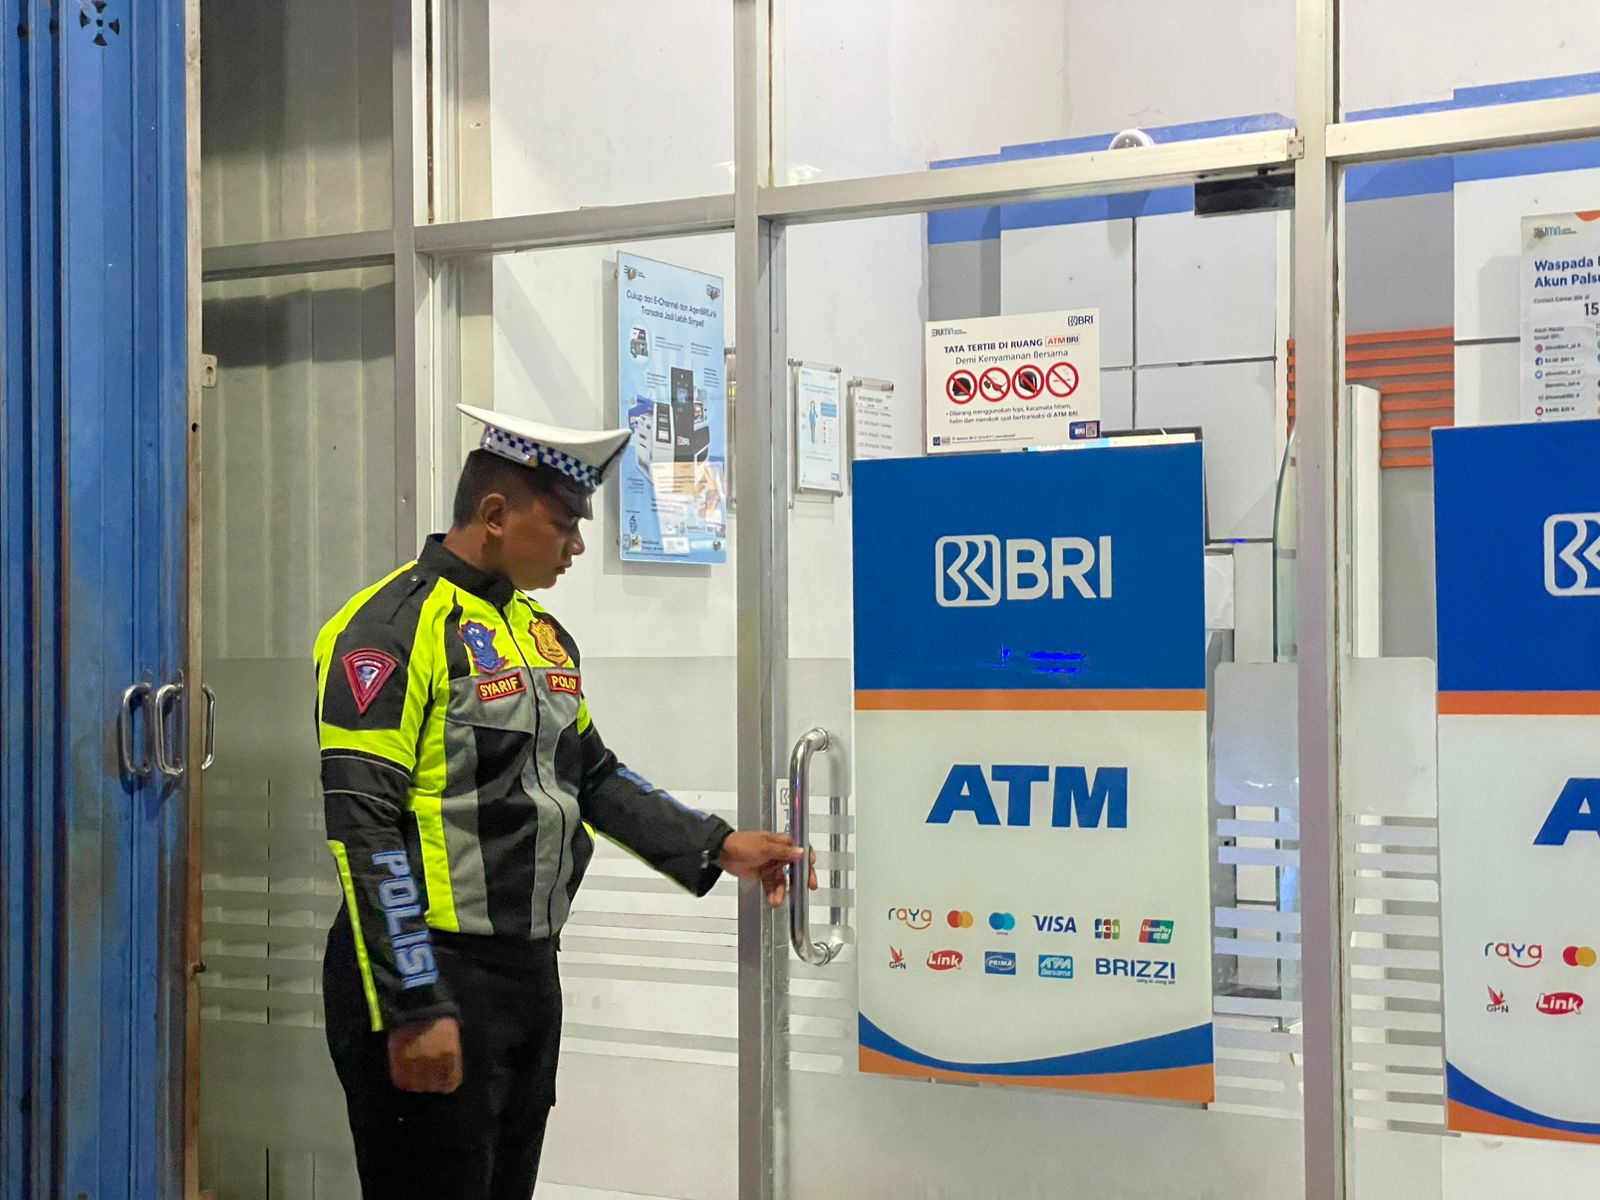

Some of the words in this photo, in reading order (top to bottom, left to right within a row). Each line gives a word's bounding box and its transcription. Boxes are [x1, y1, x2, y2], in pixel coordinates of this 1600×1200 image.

[1534, 256, 1594, 272] Waspada
[1534, 275, 1568, 288] Akun
[1078, 315, 1094, 325] BRI
[944, 345, 965, 354] TATA
[967, 342, 996, 352] TERTIB
[998, 341, 1008, 350] DI
[1010, 338, 1043, 348] RUANG
[955, 355, 976, 365] Demi
[978, 353, 1031, 364] Kenyamanan
[1033, 350, 1069, 359] Bersama
[1005, 535, 1113, 600] BRI
[479, 676, 519, 697] SYARIF
[925, 764, 1129, 829] ATM
[371, 850, 440, 990] POLISI
[888, 907, 932, 928] raya
[1032, 914, 1077, 934] VISA
[928, 951, 961, 969] Link
[987, 959, 1013, 967] PRIMA
[1040, 957, 1071, 969] ATM
[1484, 942, 1542, 965] raya
[1040, 968, 1071, 977] Bersama
[1095, 957, 1176, 980] BRIZZI
[1537, 993, 1582, 1014] Link
